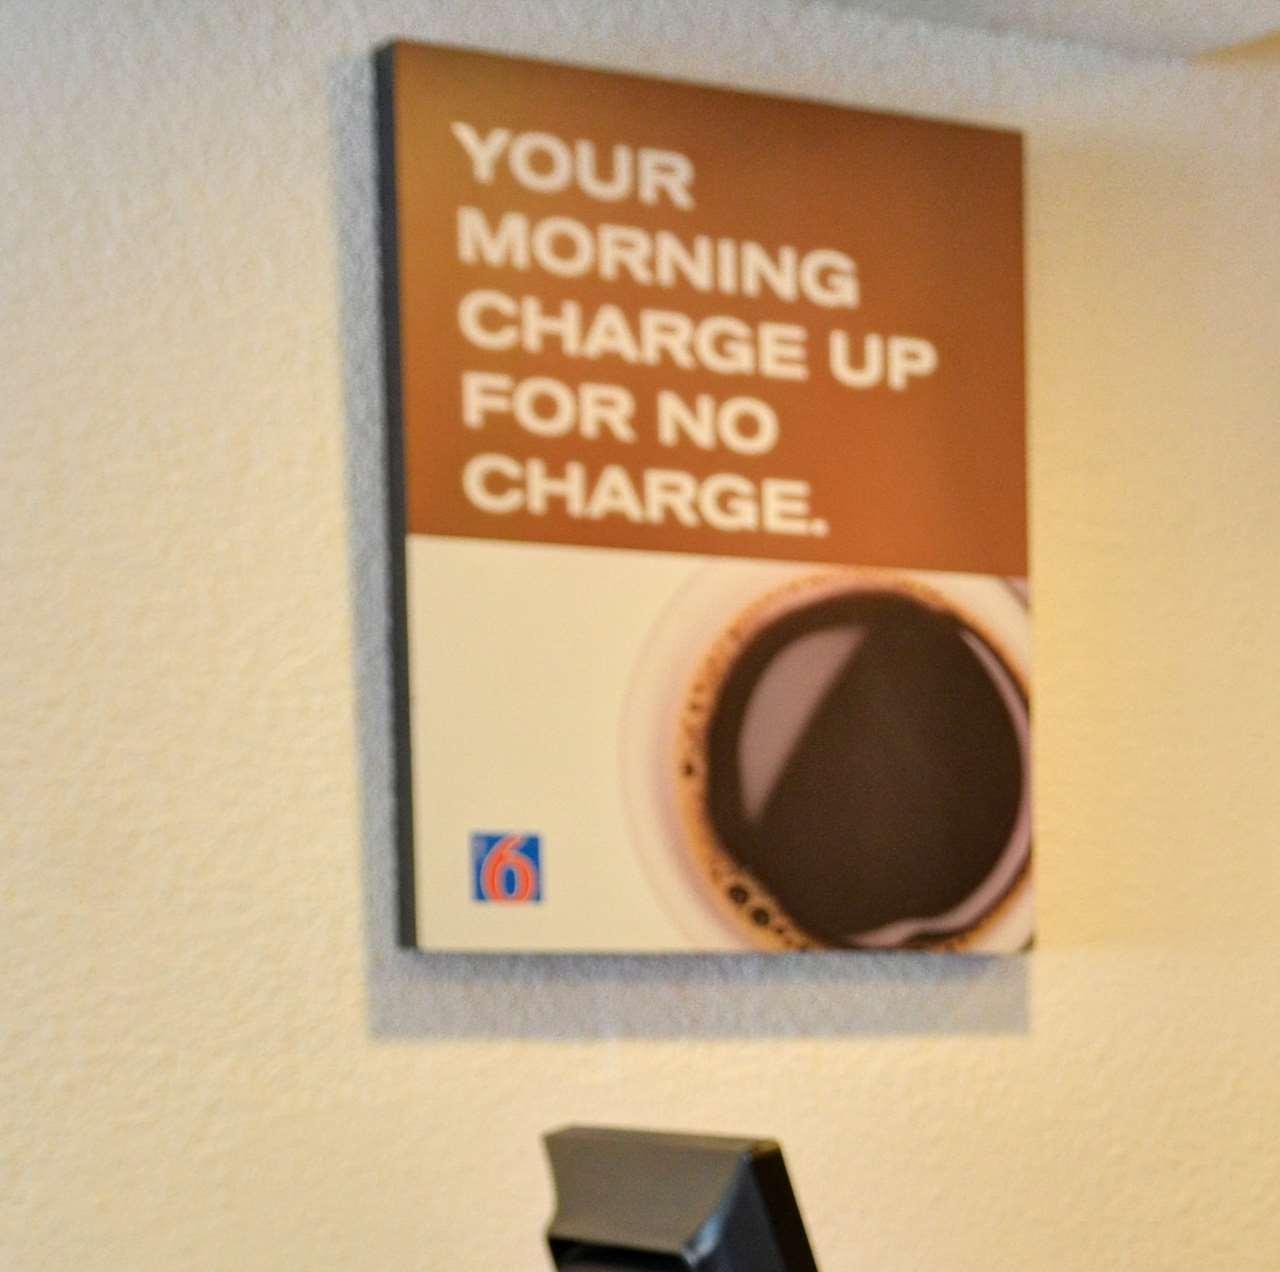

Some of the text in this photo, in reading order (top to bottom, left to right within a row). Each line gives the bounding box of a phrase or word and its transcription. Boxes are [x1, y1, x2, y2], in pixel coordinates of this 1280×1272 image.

[452, 121, 696, 211] YOUR
[456, 205, 862, 309] MORNING
[457, 289, 939, 391] CHARGE UP
[460, 370, 780, 456] FOR NO
[461, 453, 830, 538] CHARGE.
